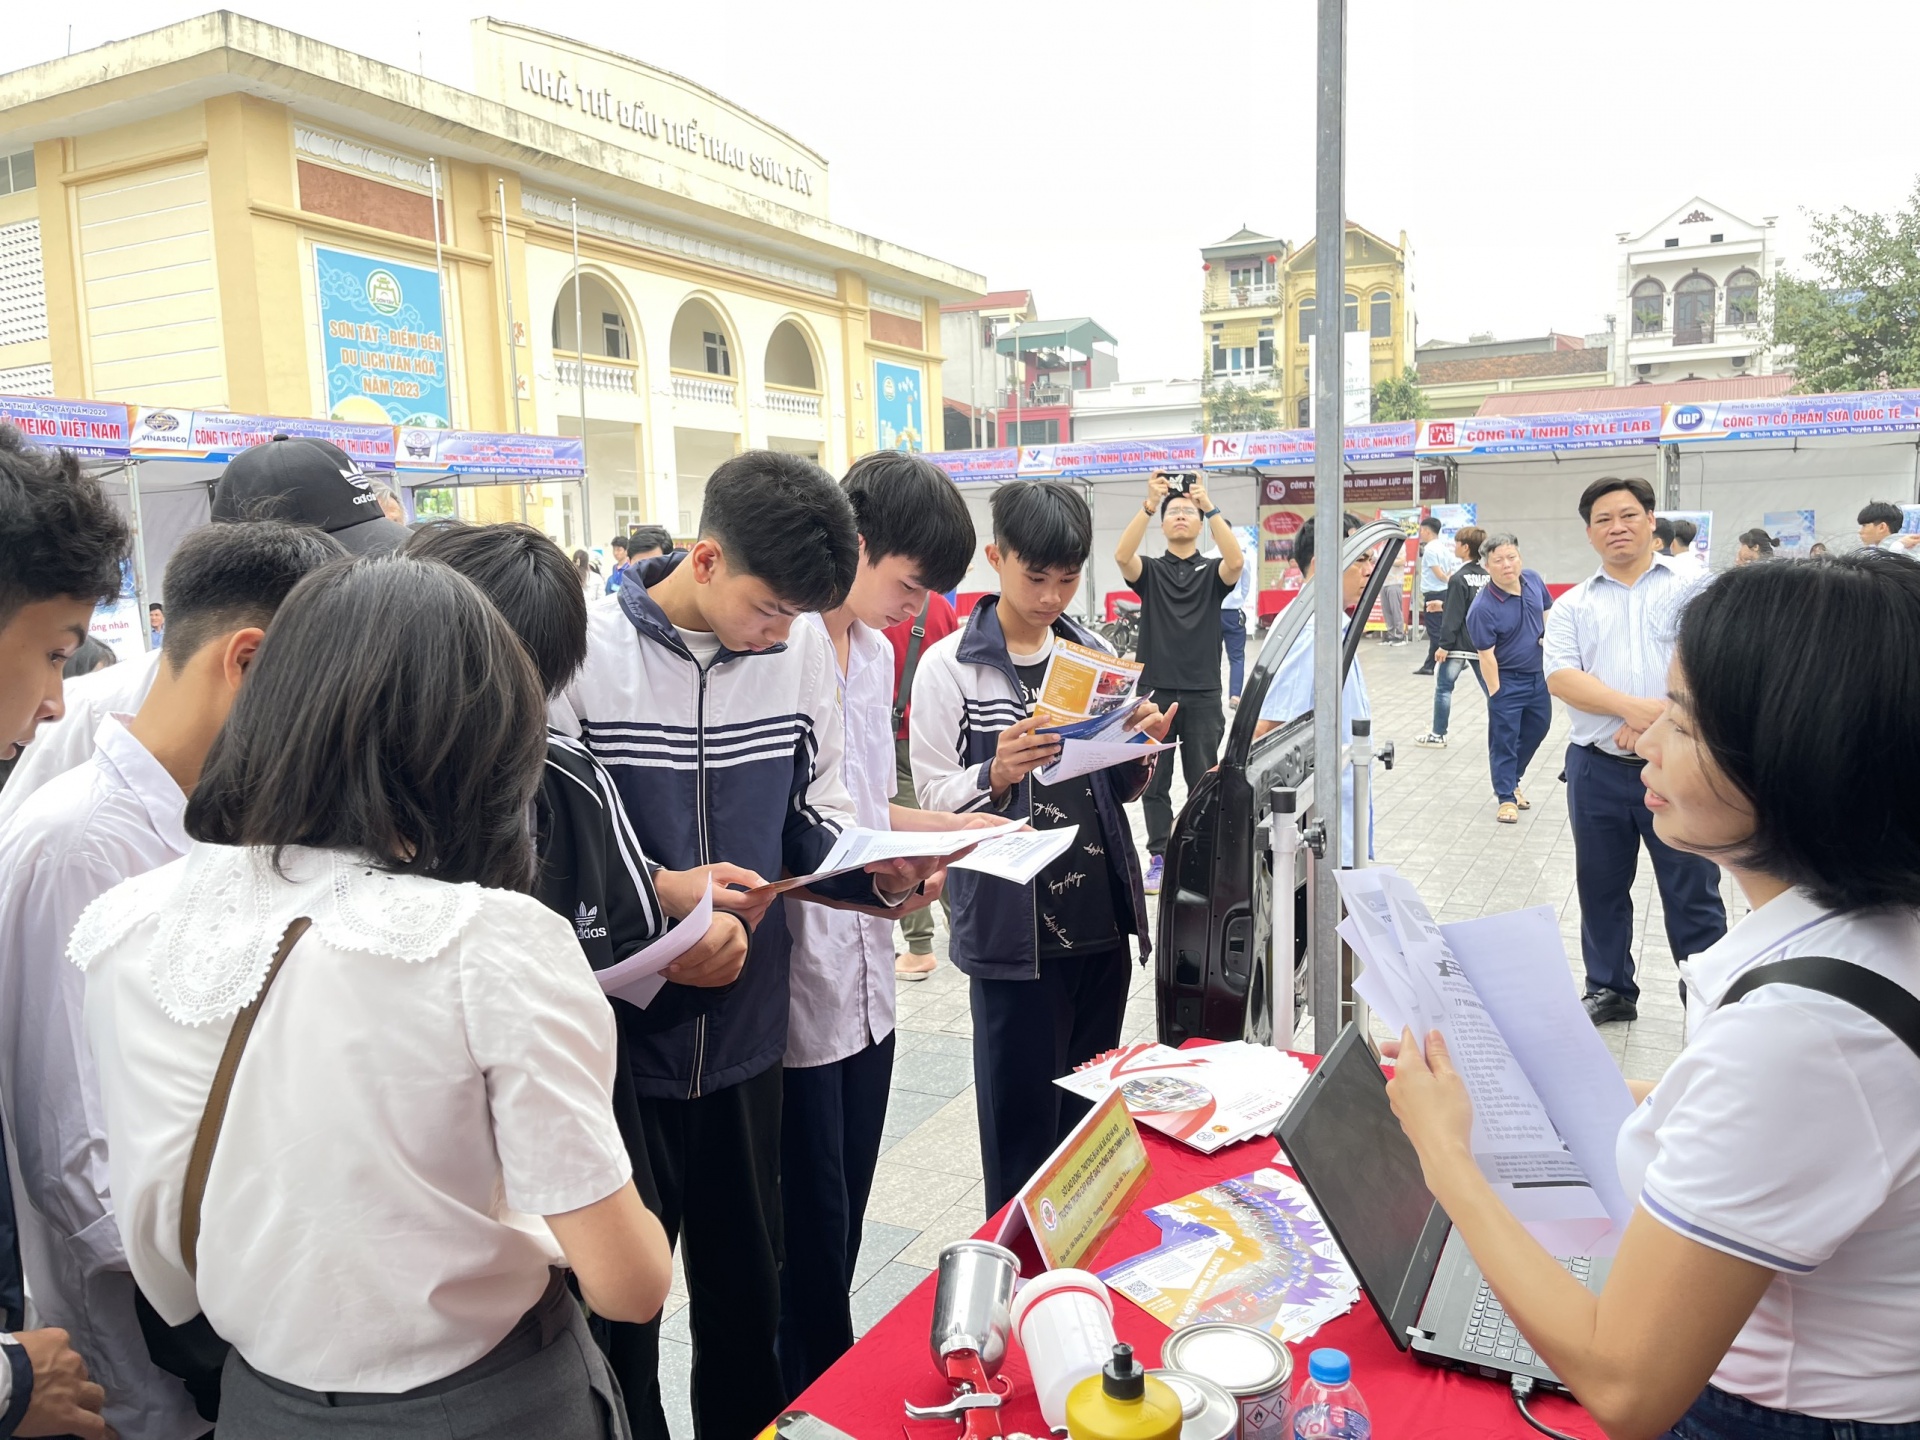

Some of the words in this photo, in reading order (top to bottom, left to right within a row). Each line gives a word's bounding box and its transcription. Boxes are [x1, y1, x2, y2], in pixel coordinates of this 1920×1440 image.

[519, 61, 573, 107] NHÀ
[701, 133, 745, 171] THAO
[750, 152, 786, 186] SƠN
[787, 167, 814, 196] TÂY
[330, 320, 354, 338] SƠN
[357, 323, 379, 342] TÂY
[389, 326, 417, 348] ĐIỂM
[420, 332, 442, 351] ĐẾN
[341, 349, 357, 365] DU
[360, 351, 386, 371] LỊCH
[389, 353, 411, 372] VĂN
[414, 359, 436, 375] HÓA
[363, 376, 390, 395] NĂM
[393, 382, 420, 398] 2023
[40, 404, 55, 412] SƠN
[71, 406, 87, 414] NĂM
[1678, 413, 1700, 425] IDP
[1723, 414, 1753, 428] CÔNG
[1758, 415, 1769, 426] TY
[15, 418, 56, 435] MEIKO
[60, 418, 87, 438] VIỆT
[91, 423, 121, 439] NAM
[195, 427, 218, 445] CÔNG
[220, 431, 229, 445] TY
[1430, 425, 1453, 434] STYLE
[1467, 429, 1505, 442] CÔNG
[1510, 428, 1525, 439] TY
[1531, 426, 1568, 439] TNHH
[1574, 423, 1617, 436] STYLE
[1623, 420, 1651, 433] LAB
[142, 434, 187, 443] VINASINCO
[1430, 433, 1453, 443] LAB
[375, 441, 390, 454] NAM
[1248, 442, 1267, 455] CÔNG
[1269, 444, 1277, 454] TY
[1279, 443, 1296, 453] TNHH
[1055, 455, 1080, 466] CÔNG
[1083, 455, 1092, 465] TY
[1096, 454, 1119, 464] TNHH
[1171, 449, 1196, 459] CARE
[88, 622, 107, 632] ông
[109, 621, 129, 630] nhân
[1068, 643, 1079, 652] CÁC
[1079, 646, 1100, 660] NGÀNH
[1100, 653, 1117, 664] NGHỀ
